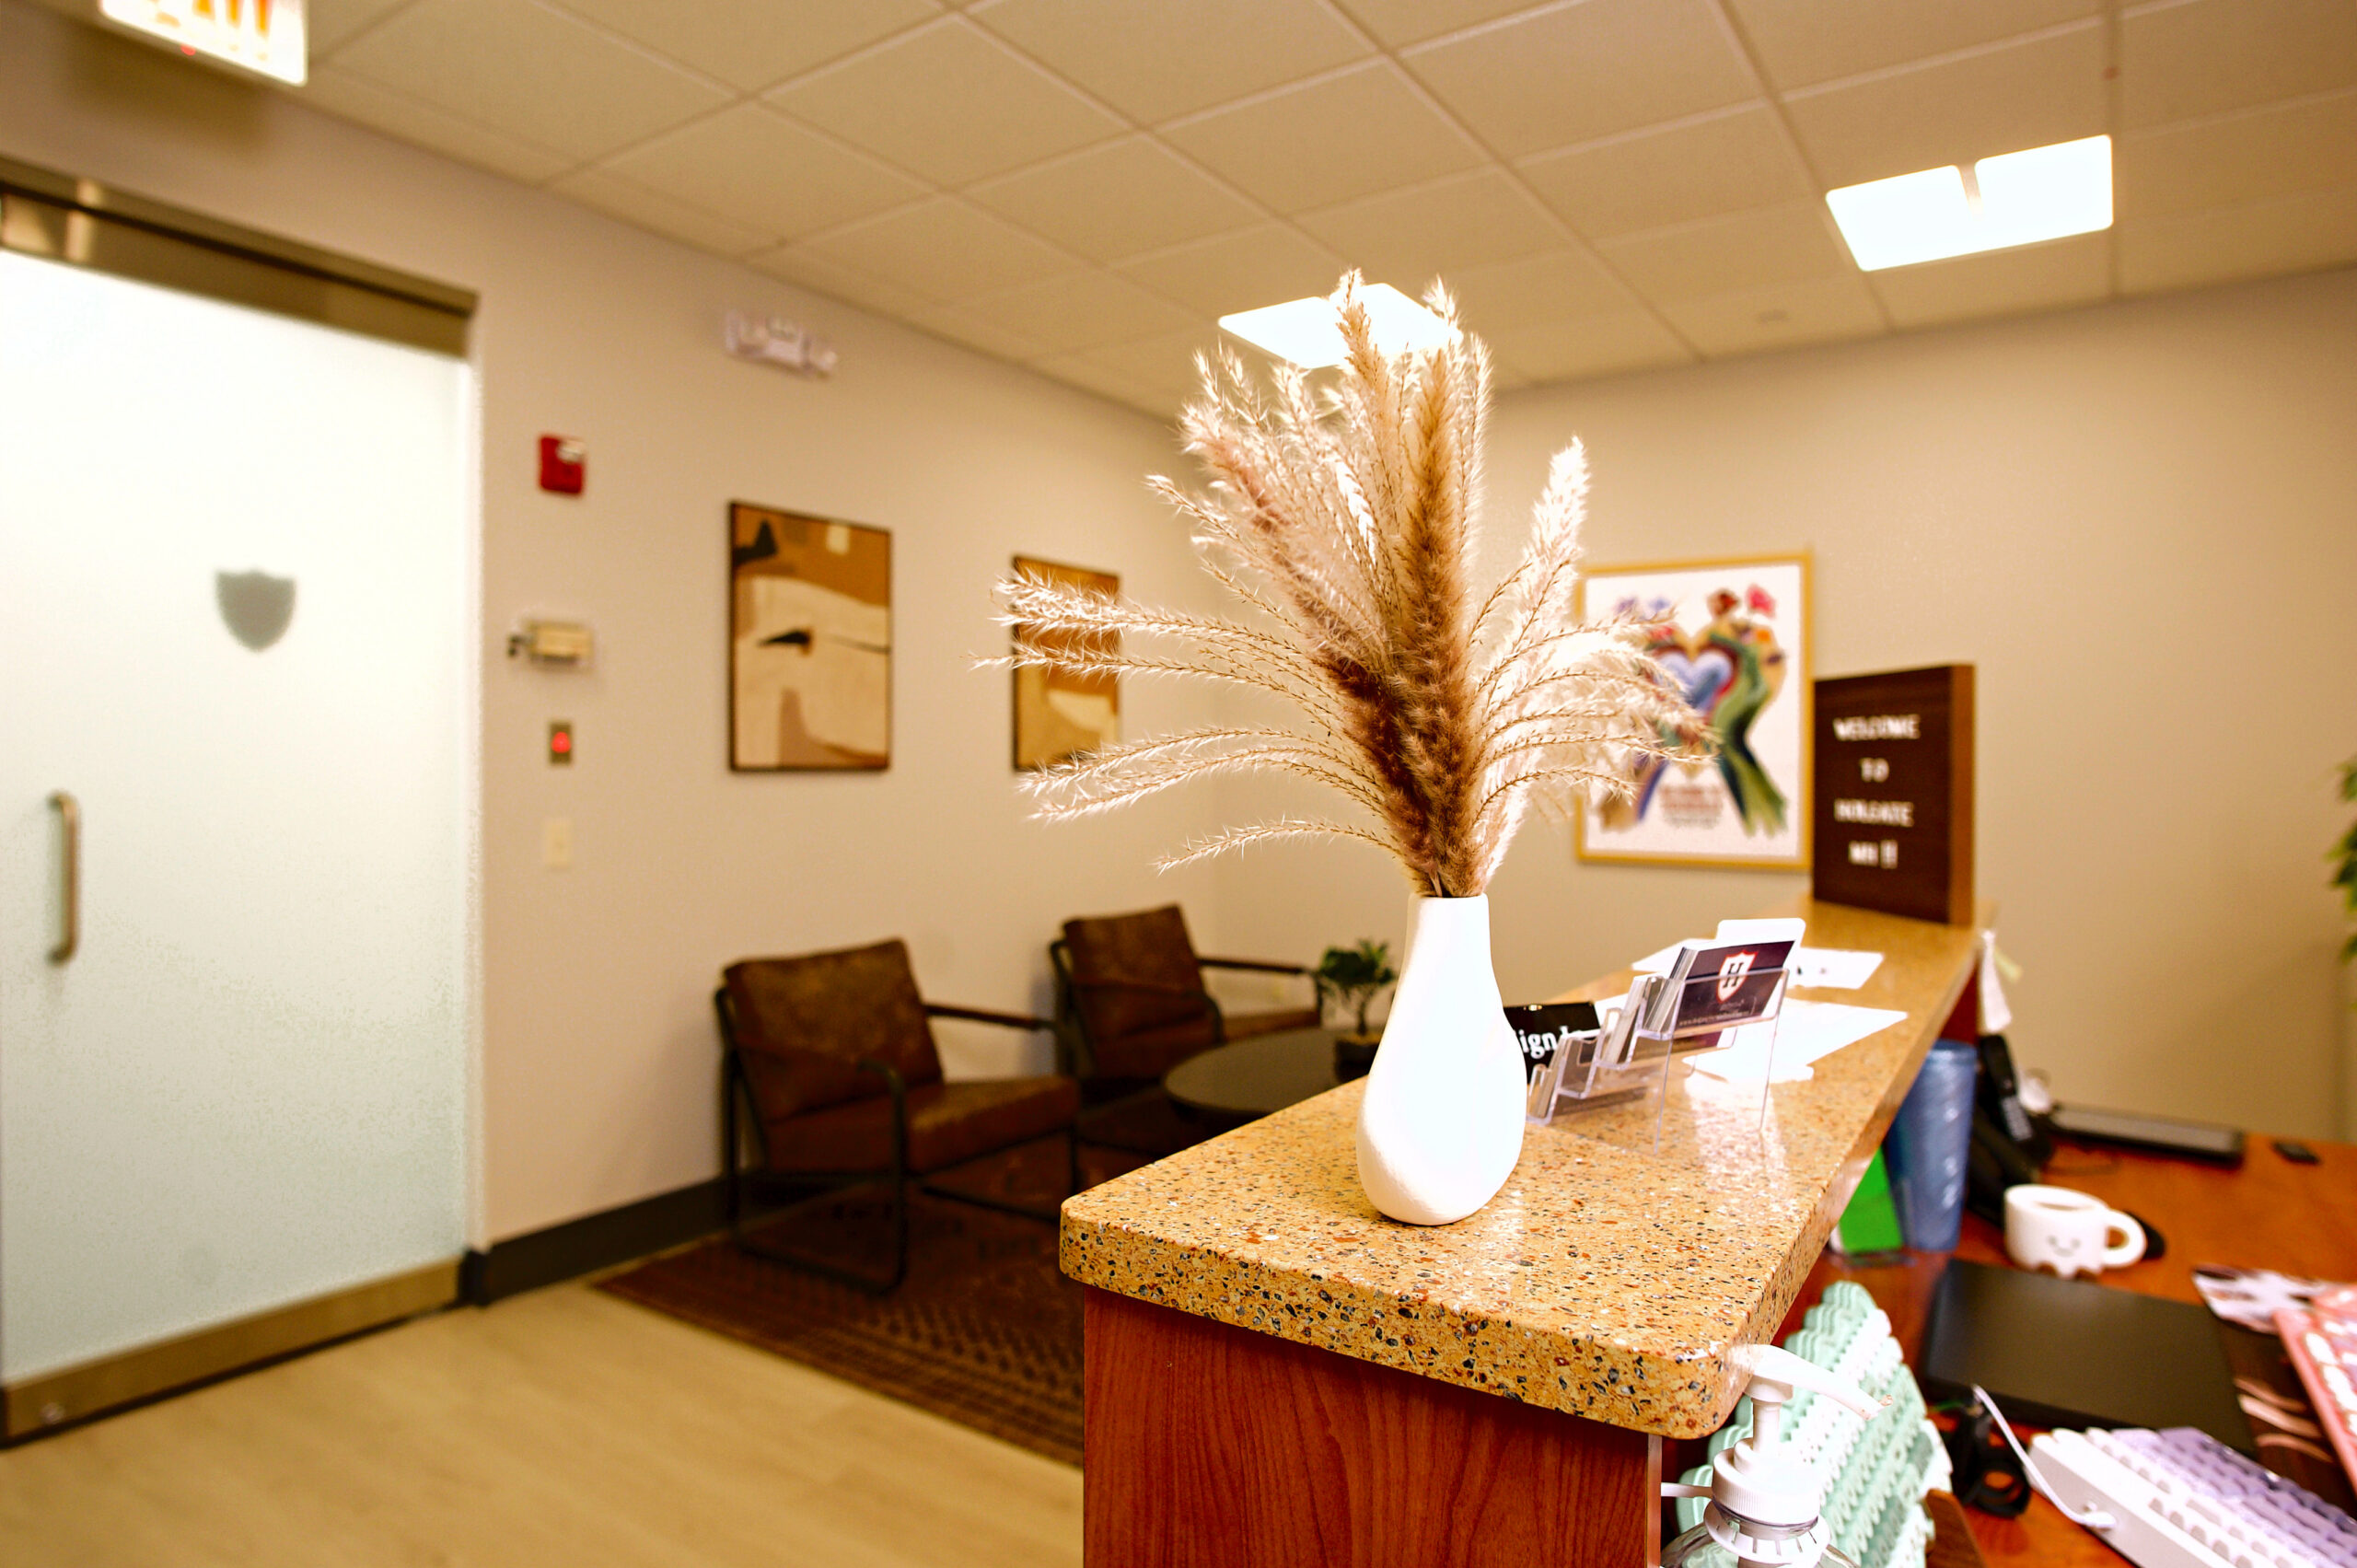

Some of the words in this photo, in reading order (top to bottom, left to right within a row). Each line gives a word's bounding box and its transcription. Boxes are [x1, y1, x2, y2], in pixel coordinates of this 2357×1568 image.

[1833, 715, 1920, 740] WELCOME
[1860, 758, 1888, 782] TO
[1722, 962, 1744, 989] H
[1517, 1028, 1559, 1059] ign
